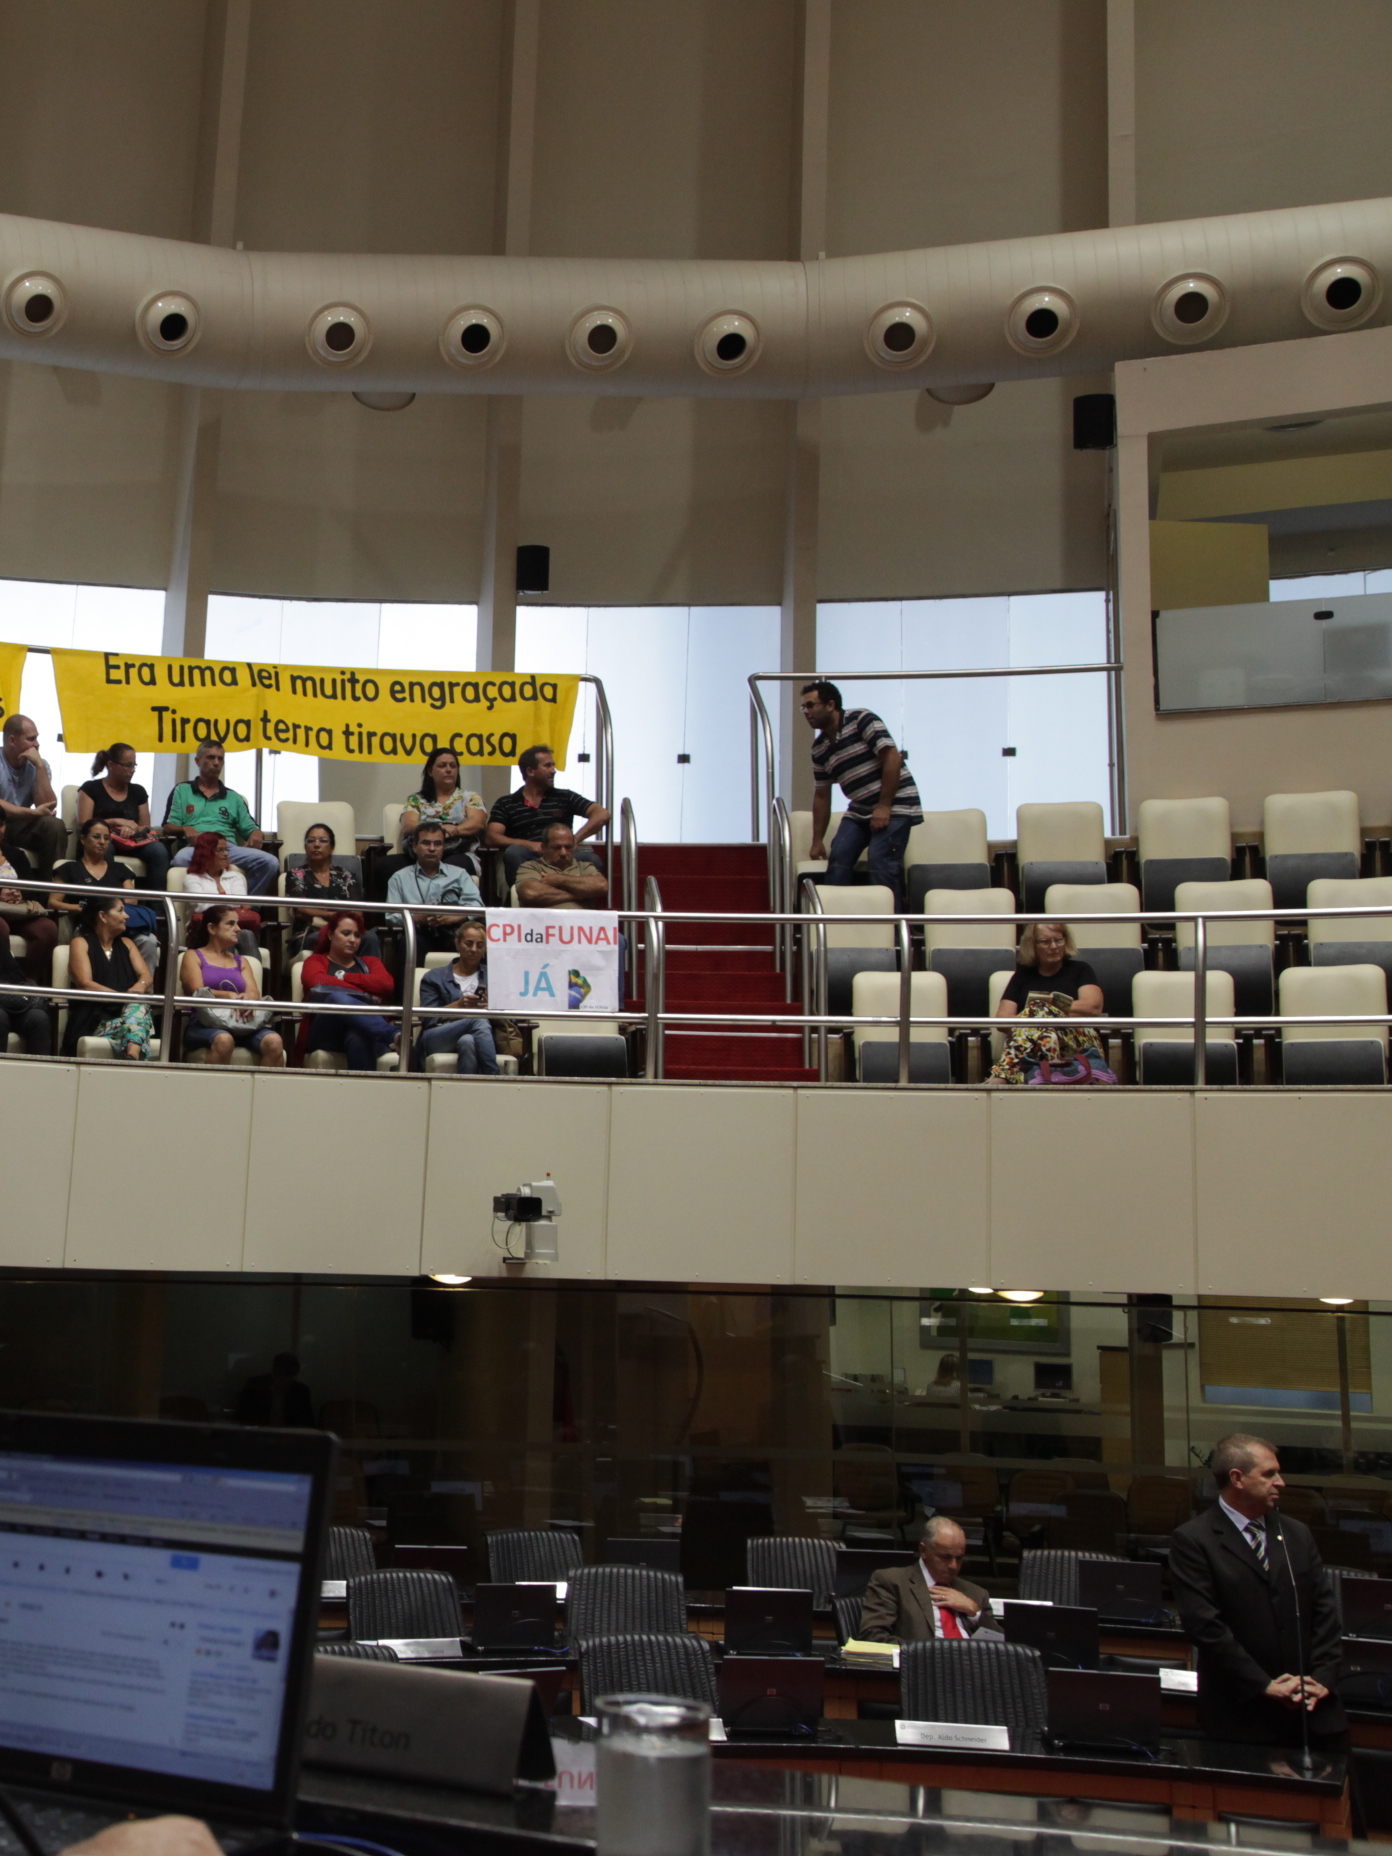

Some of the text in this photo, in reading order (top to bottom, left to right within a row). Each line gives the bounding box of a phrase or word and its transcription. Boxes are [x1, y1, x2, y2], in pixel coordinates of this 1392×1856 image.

[103, 652, 558, 711] Era uma lei muito engraçada
[150, 705, 518, 758] Tirava terra tirava casa
[519, 963, 556, 998] JÁ
[346, 1717, 411, 1753] Titon
[920, 1732, 987, 1744] Dep. Aldo Schneider
